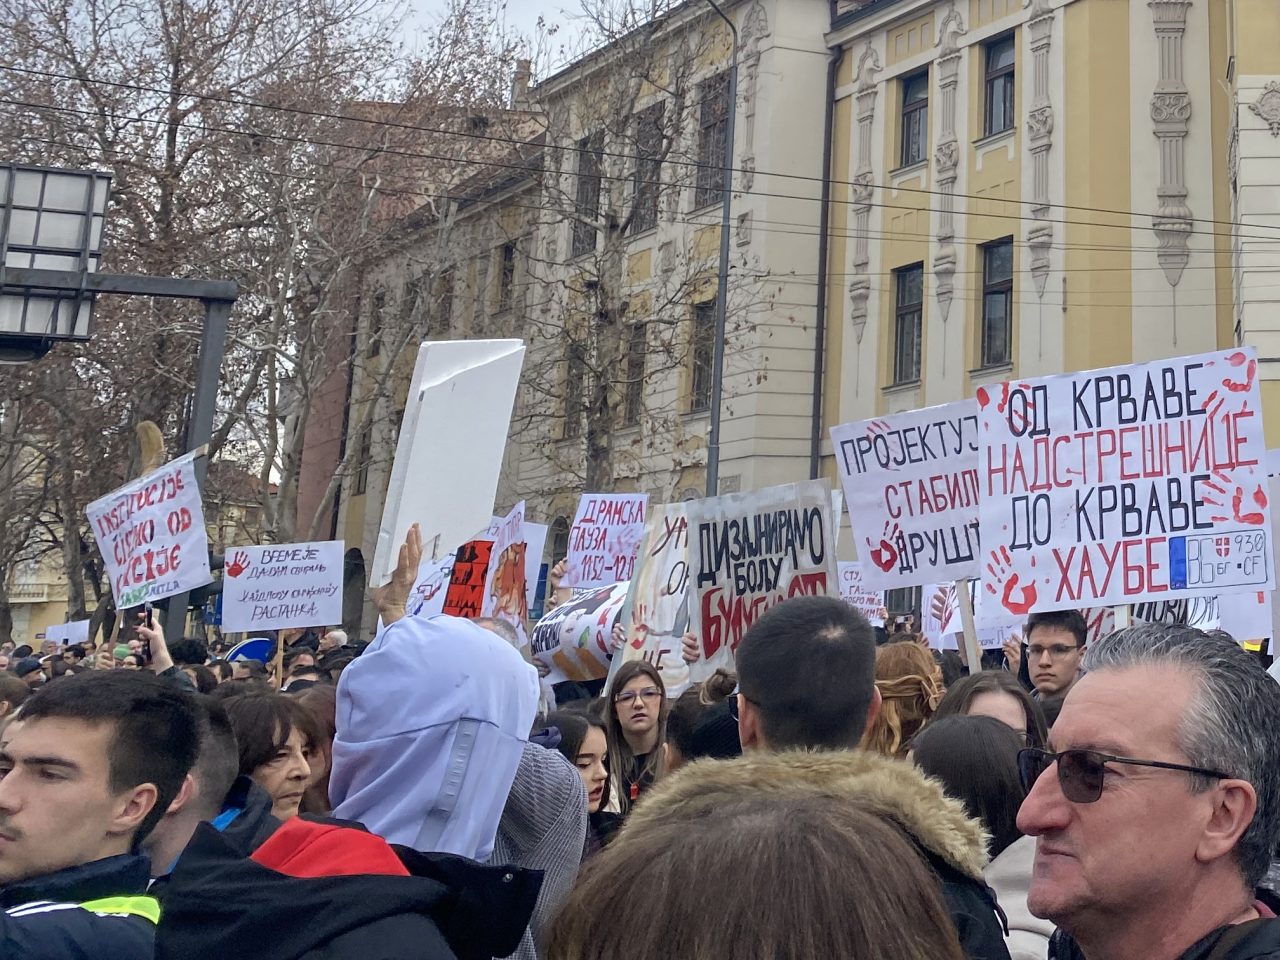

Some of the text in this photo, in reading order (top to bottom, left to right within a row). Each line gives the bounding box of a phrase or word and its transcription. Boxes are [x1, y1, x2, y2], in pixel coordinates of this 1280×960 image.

[1008, 363, 1207, 438] ОД КРВАВЕ
[987, 411, 1258, 496] НАДСТРЕШНИЦЕ
[579, 500, 643, 525] ДРАМСКА
[885, 468, 979, 519] СТАБИЛ
[1009, 474, 1214, 551] ДО КРВАВЕ
[167, 507, 192, 537] OD
[568, 526, 608, 551] ПАУЗА
[1234, 533, 1264, 554] 930
[261, 549, 302, 564] ВРЕМЕ
[698, 506, 824, 589] ДИЗАЈНИРАМО
[1052, 537, 1168, 602] ХАУБЕ
[735, 557, 783, 596] БОЉУ
